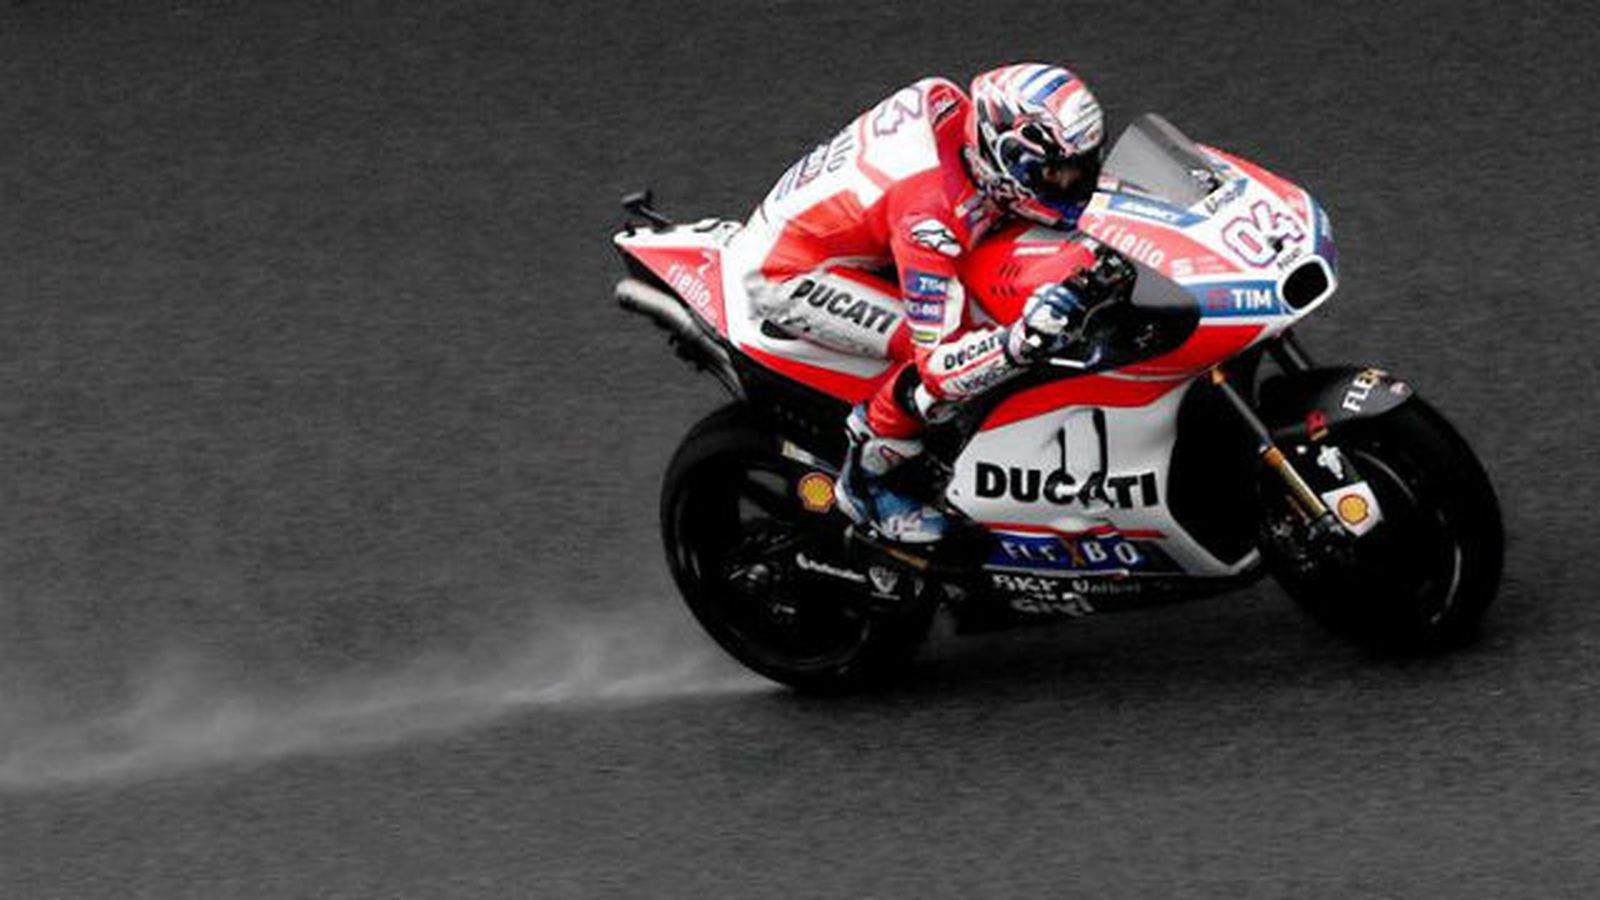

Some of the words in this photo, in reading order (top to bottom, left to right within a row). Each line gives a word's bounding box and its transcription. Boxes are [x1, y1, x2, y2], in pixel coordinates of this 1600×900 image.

[790, 279, 899, 335] DUCATI
[1231, 288, 1272, 310] TIM
[974, 461, 1160, 510] DUCATI
